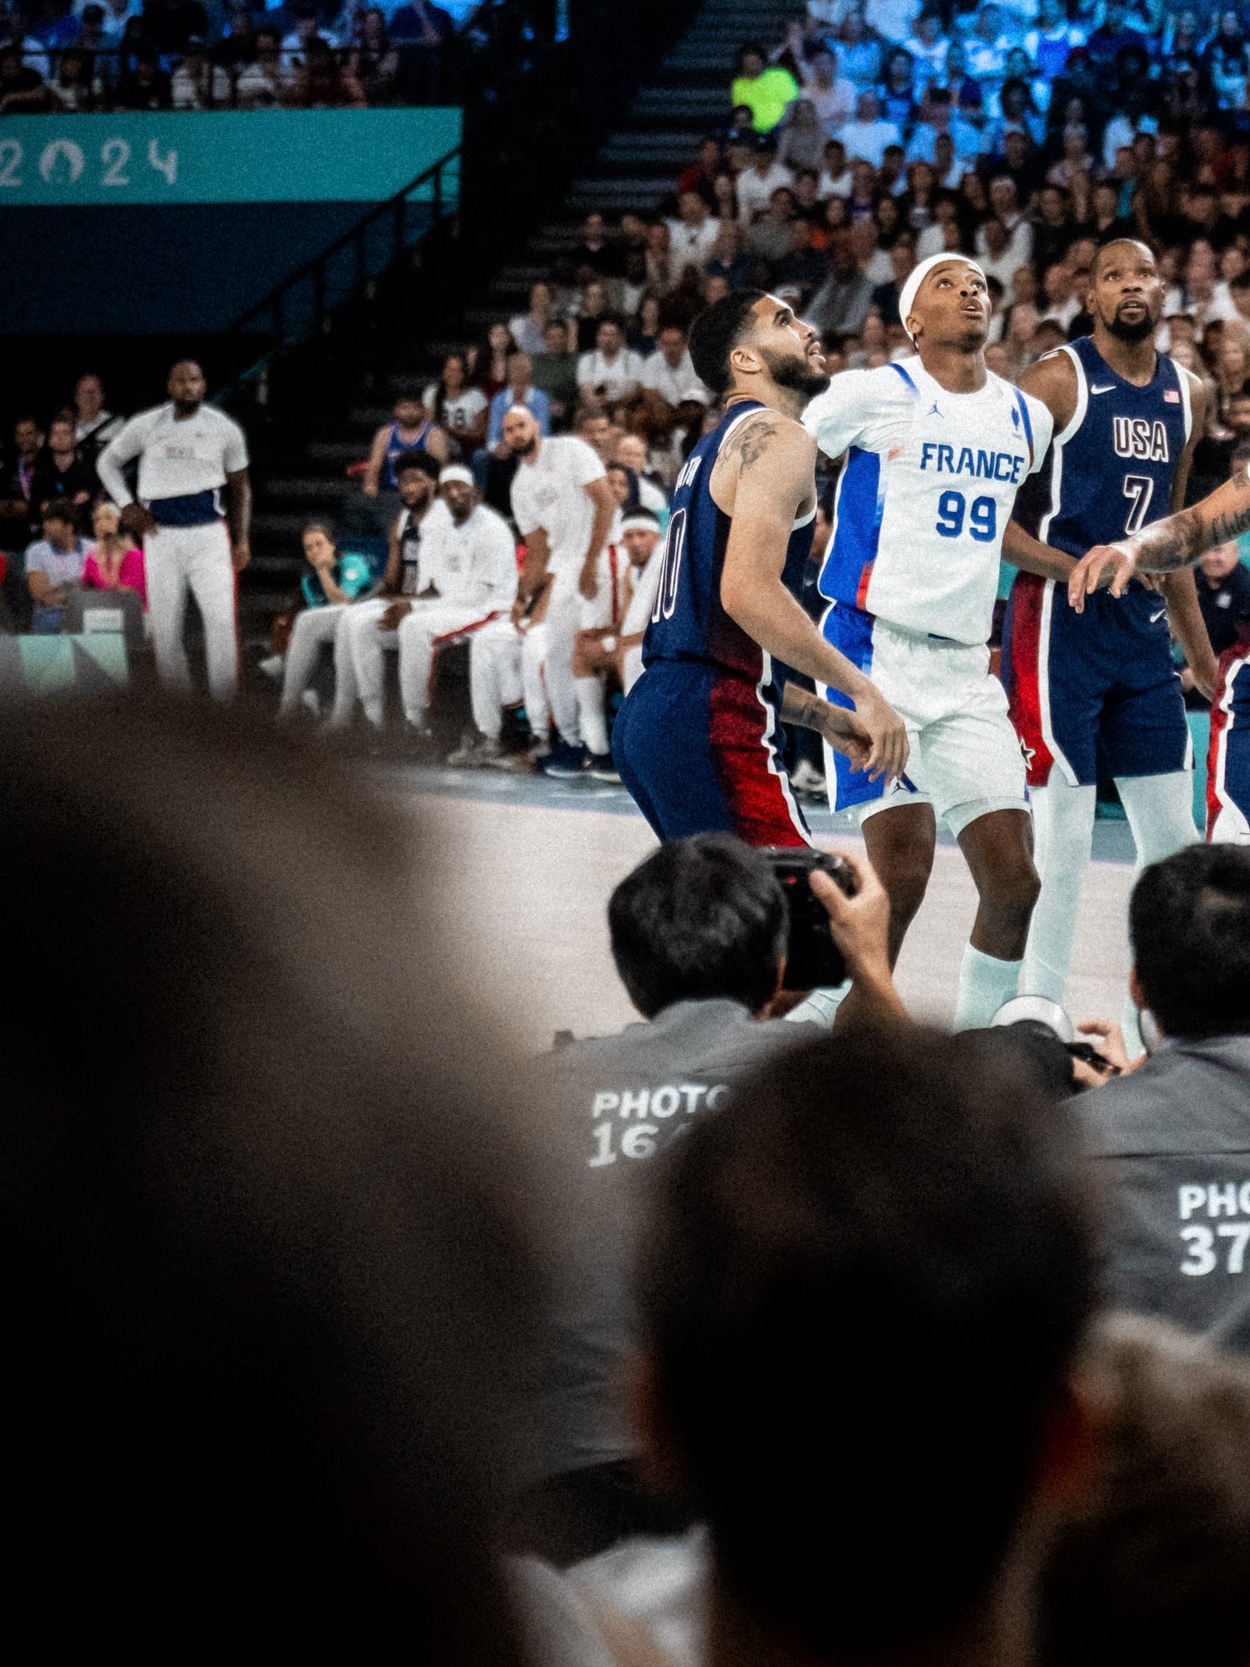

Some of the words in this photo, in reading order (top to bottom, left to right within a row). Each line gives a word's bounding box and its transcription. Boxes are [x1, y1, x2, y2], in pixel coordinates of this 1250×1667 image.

[0, 138, 178, 186] 2024
[920, 442, 1025, 485] FRANCE
[1113, 417, 1169, 463] USA
[935, 490, 997, 543] 99
[1122, 474, 1154, 536] 7
[588, 1121, 692, 1168] 16
